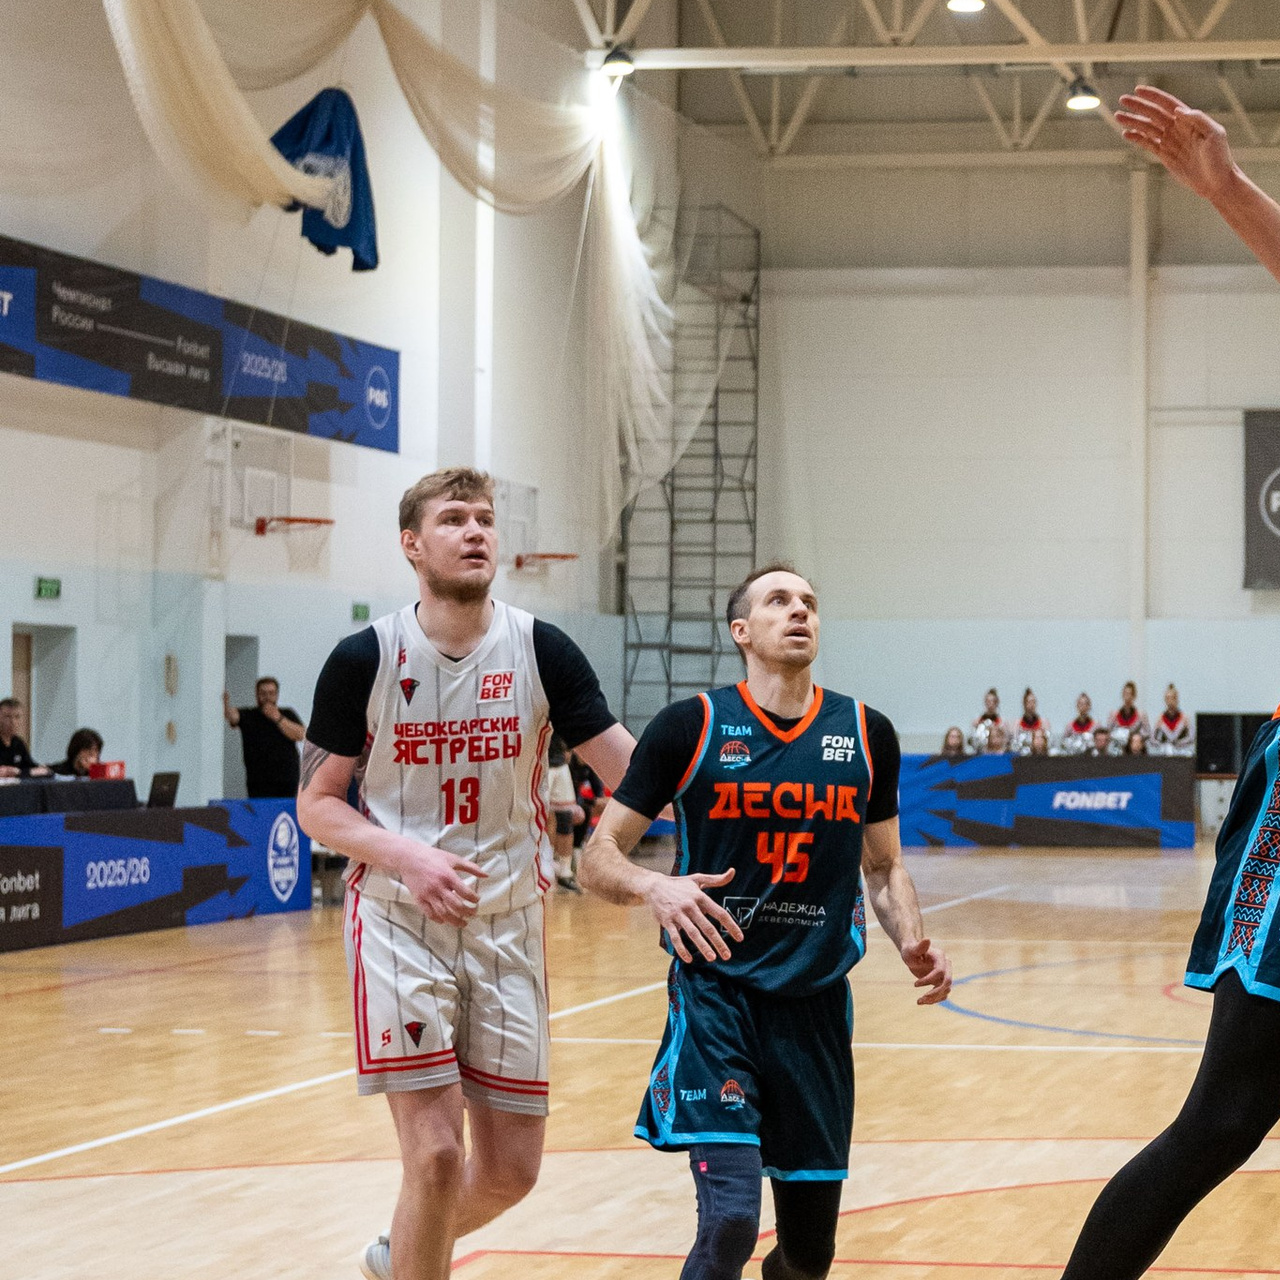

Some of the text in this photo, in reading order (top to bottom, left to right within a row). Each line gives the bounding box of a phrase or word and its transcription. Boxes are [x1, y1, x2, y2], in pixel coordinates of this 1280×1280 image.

[482, 673, 513, 687] FON
[480, 686, 511, 700] BET
[393, 717, 520, 738] ЧЕБОКСАРСКИЕ
[721, 724, 752, 736] TEAM
[393, 733, 522, 765] ЯСТРЕБЫ
[821, 735, 855, 748] FON
[822, 748, 856, 762] BET
[441, 776, 480, 825] 13
[708, 781, 861, 824] ДЕСНА
[1052, 791, 1133, 810] FONBET
[756, 832, 814, 884] 45
[0, 869, 40, 894] onbet
[86, 856, 150, 890] 2025/26
[762, 901, 826, 917] НАДЕЖДА
[679, 1088, 707, 1101] TEAM
